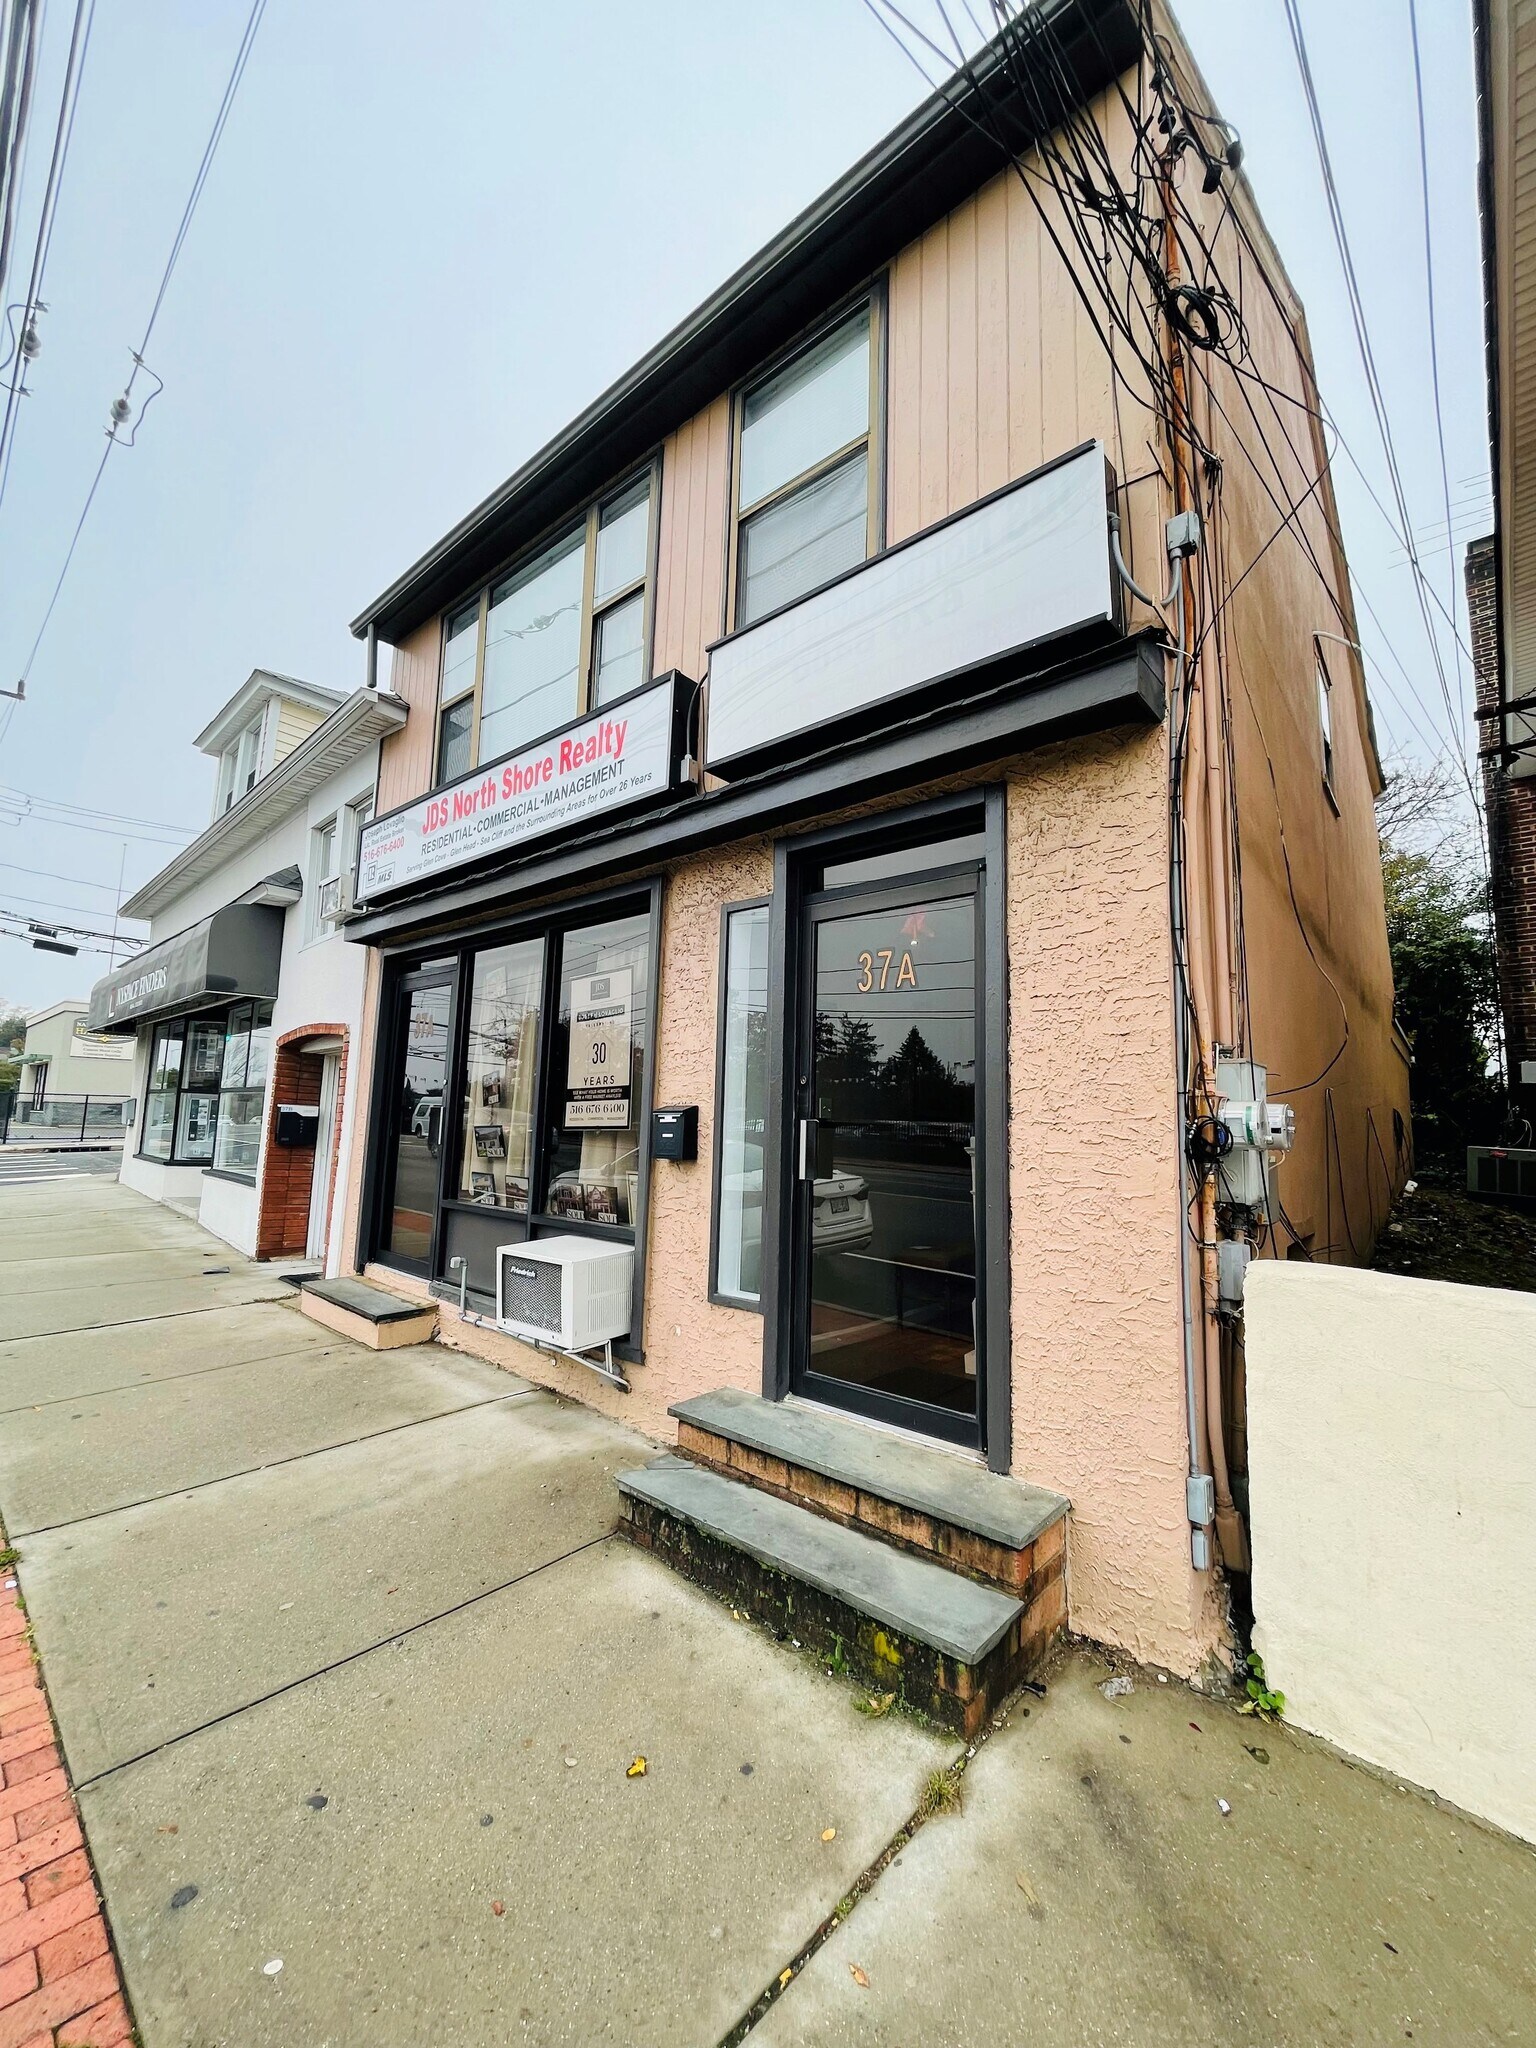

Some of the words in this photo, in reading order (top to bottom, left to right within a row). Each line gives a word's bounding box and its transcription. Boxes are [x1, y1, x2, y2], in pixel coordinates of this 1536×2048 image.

[422, 797, 449, 835] JDS
[453, 776, 497, 822] North
[502, 756, 553, 800] Shore
[559, 718, 628, 775] Realty
[365, 825, 382, 840] Joseph
[406, 862, 422, 874] Serving
[423, 856, 434, 867] Glen
[434, 852, 446, 863] Cove
[450, 845, 462, 857] Glen
[462, 841, 476, 852] Head
[480, 836, 491, 846] Sea
[491, 830, 504, 845] Cliff
[503, 825, 516, 837] and
[515, 819, 525, 832] the
[526, 804, 566, 829] Surrounding
[566, 798, 586, 812] Areas
[587, 793, 598, 805] for
[600, 786, 617, 799] Over
[619, 780, 628, 792] 26
[630, 772, 652, 786] Years
[363, 835, 405, 862] 516-676-6400
[377, 870, 392, 884] MLS
[857, 949, 916, 993] 37A
[592, 1042, 606, 1065] 30
[583, 1075, 615, 1086] YEARS
[569, 1104, 584, 1114] 516
[585, 1104, 601, 1114] 676
[510, 1265, 537, 1278] Friedrich
